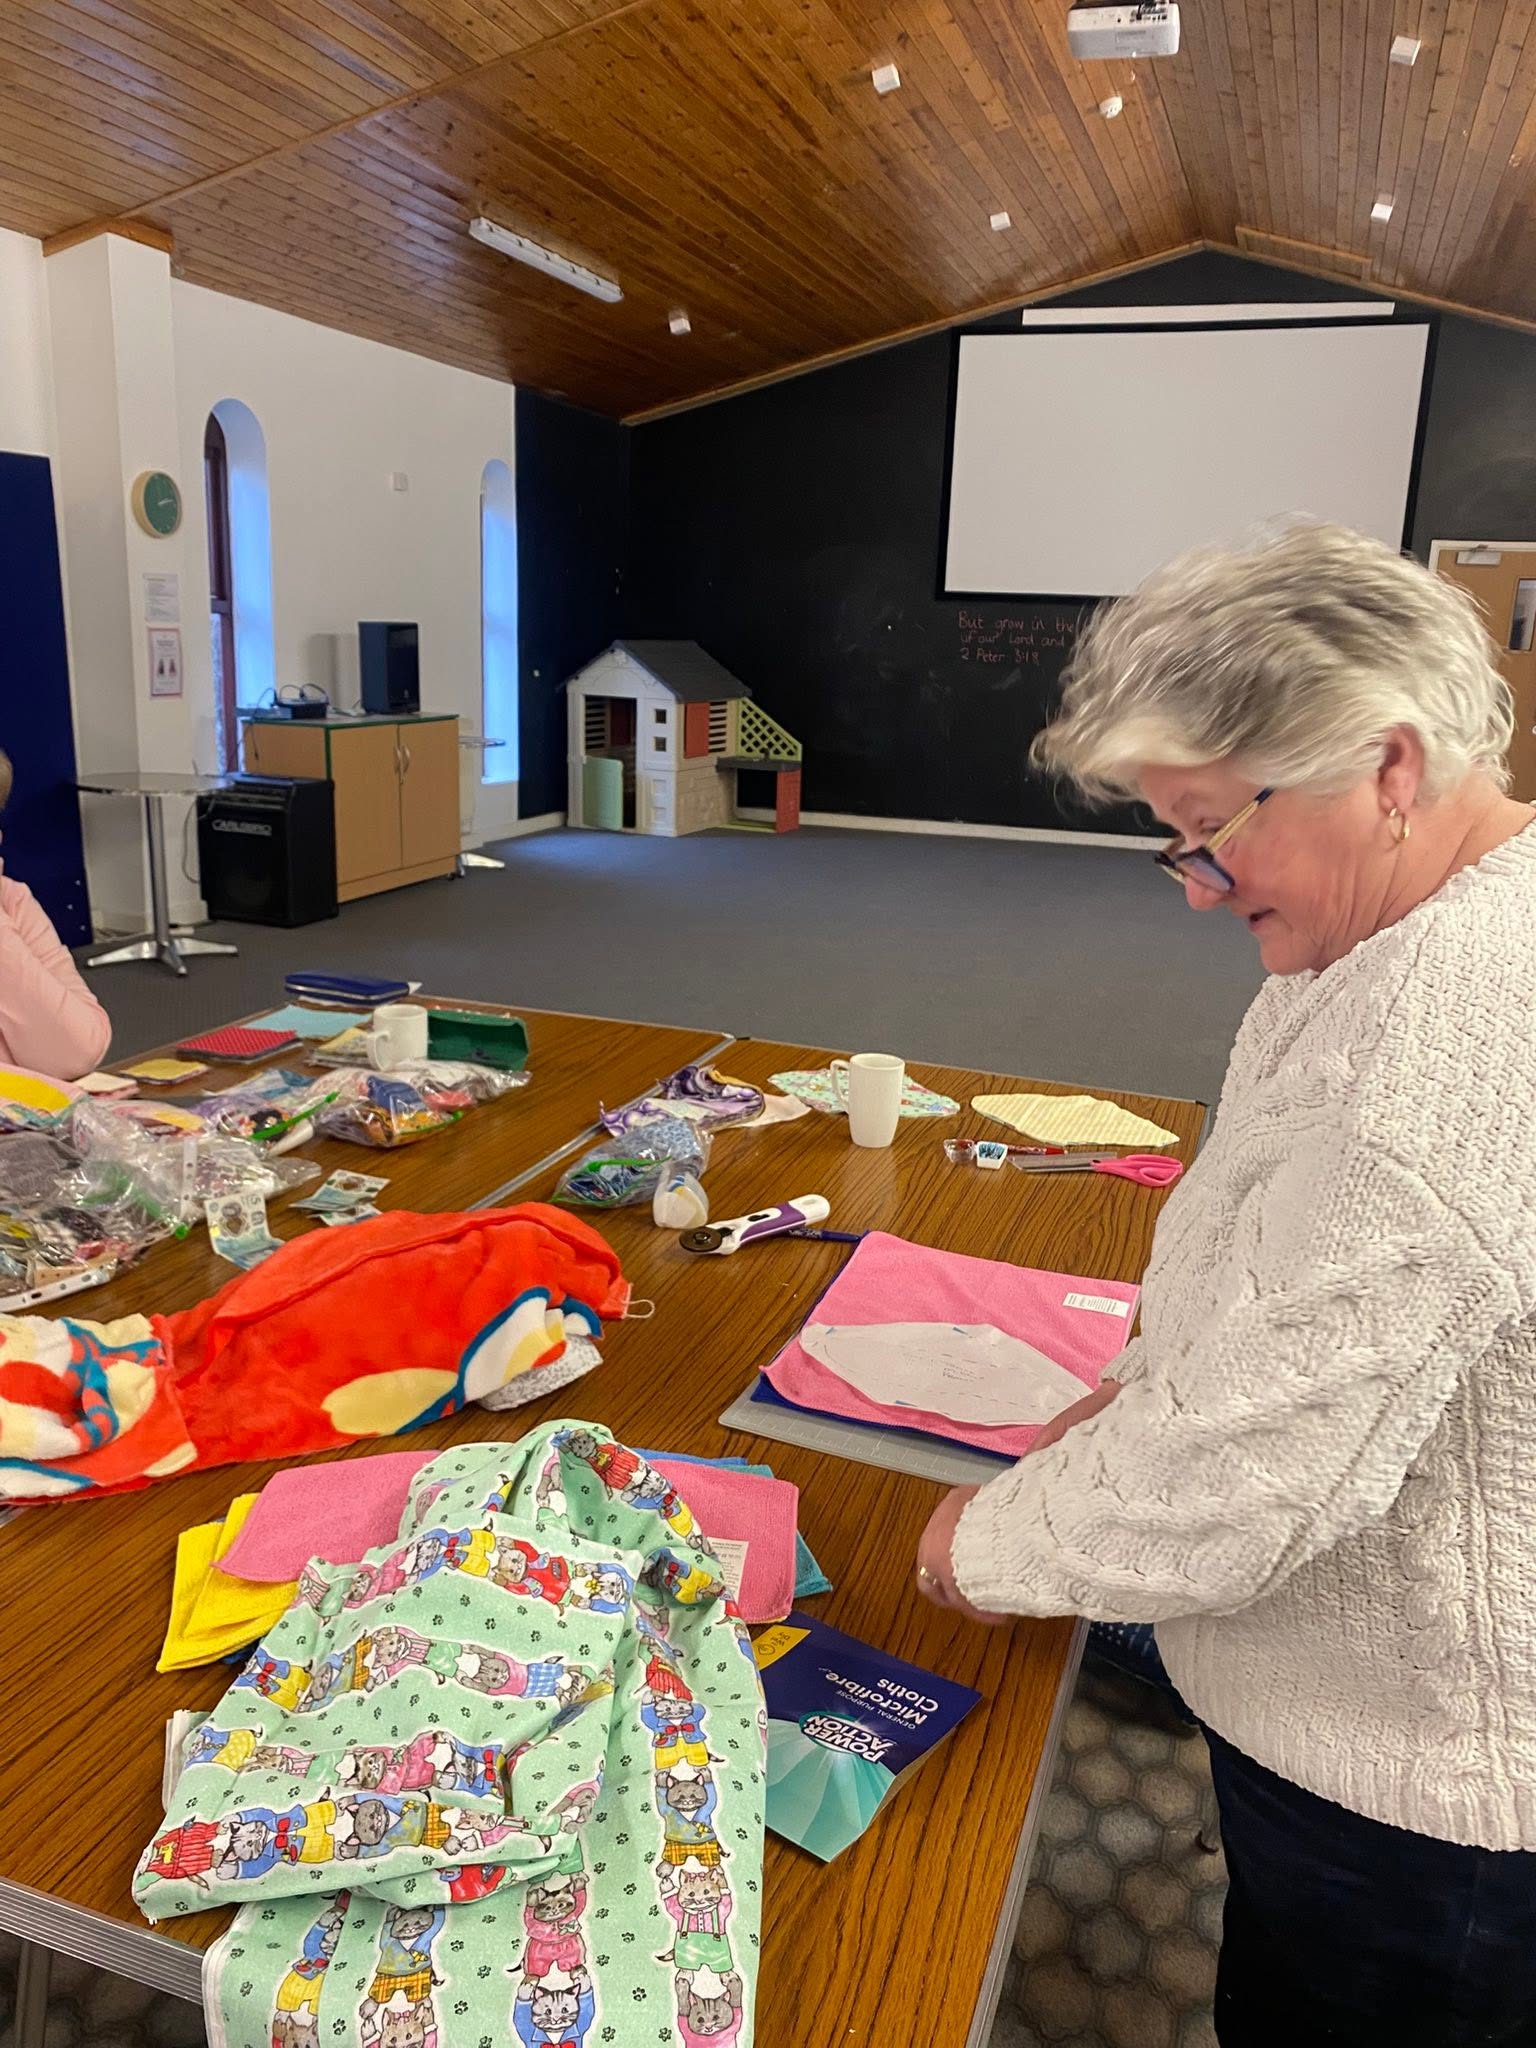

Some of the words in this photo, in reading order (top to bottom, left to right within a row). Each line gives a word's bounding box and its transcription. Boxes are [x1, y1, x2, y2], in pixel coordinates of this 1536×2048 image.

[958, 610, 984, 629] But
[994, 618, 1024, 633] grow
[1031, 615, 1046, 630] in
[1055, 616, 1074, 633] the
[1008, 631, 1034, 646] Lord
[1041, 634, 1065, 648] and
[960, 647, 970, 660] 2
[976, 648, 1006, 662] Peter
[825, 1672, 928, 1725] Microfibre
[836, 1689, 875, 1712] PURPOSE
[877, 1678, 939, 1712] Cloths
[876, 1708, 916, 1730] GENERAL
[803, 1723, 886, 1762] POWER
[806, 1715, 894, 1751] ACTION
